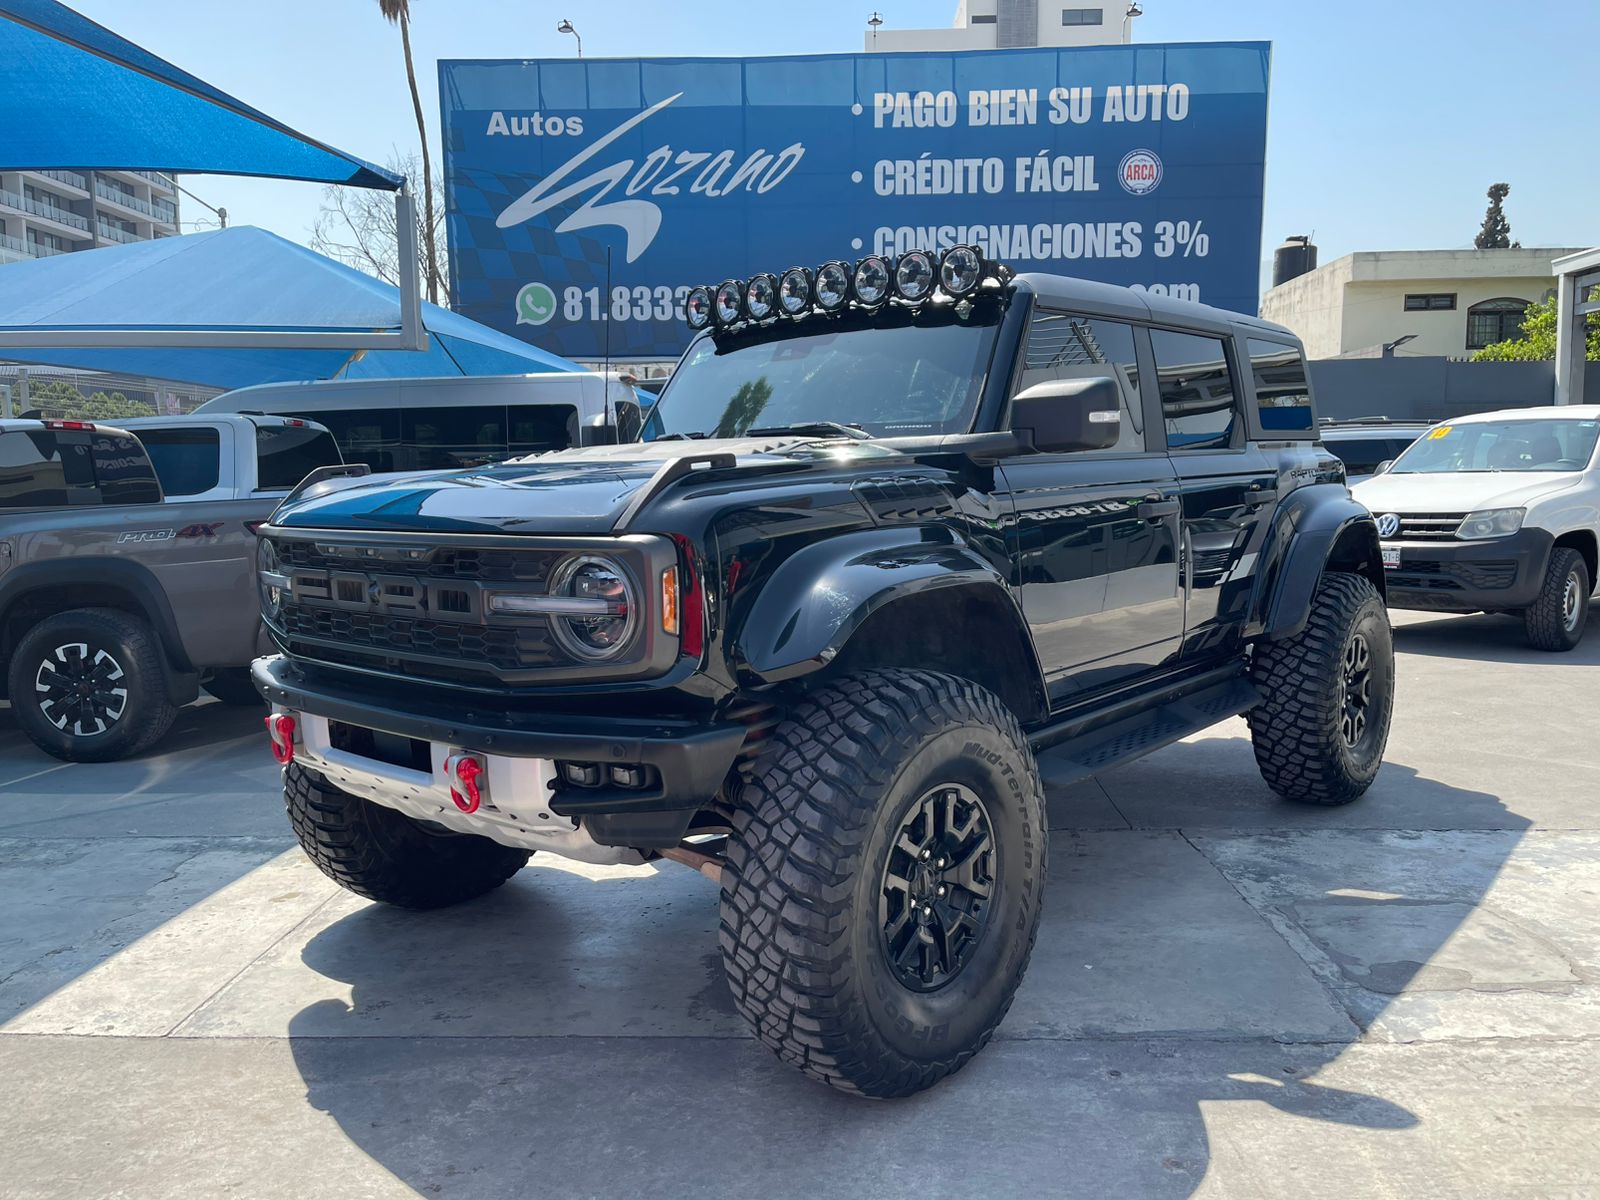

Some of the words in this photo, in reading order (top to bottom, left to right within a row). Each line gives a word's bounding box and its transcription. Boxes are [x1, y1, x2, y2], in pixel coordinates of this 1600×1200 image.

[486, 111, 584, 137] Autos
[873, 91, 957, 128] PAGO
[968, 88, 1037, 126] BIEN
[1048, 86, 1093, 123] SU
[1103, 83, 1190, 122] AUTO
[873, 152, 1005, 195] CRÉDITO
[1015, 149, 1100, 192] FÁCIL
[1126, 164, 1155, 180] ARCA
[873, 223, 1143, 260] CONSIGNACIONES
[1153, 220, 1210, 257] 3%
[290, 566, 482, 625] FORD
[963, 740, 1034, 870] Mud-Terrain
[1016, 877, 1033, 932] T/A
